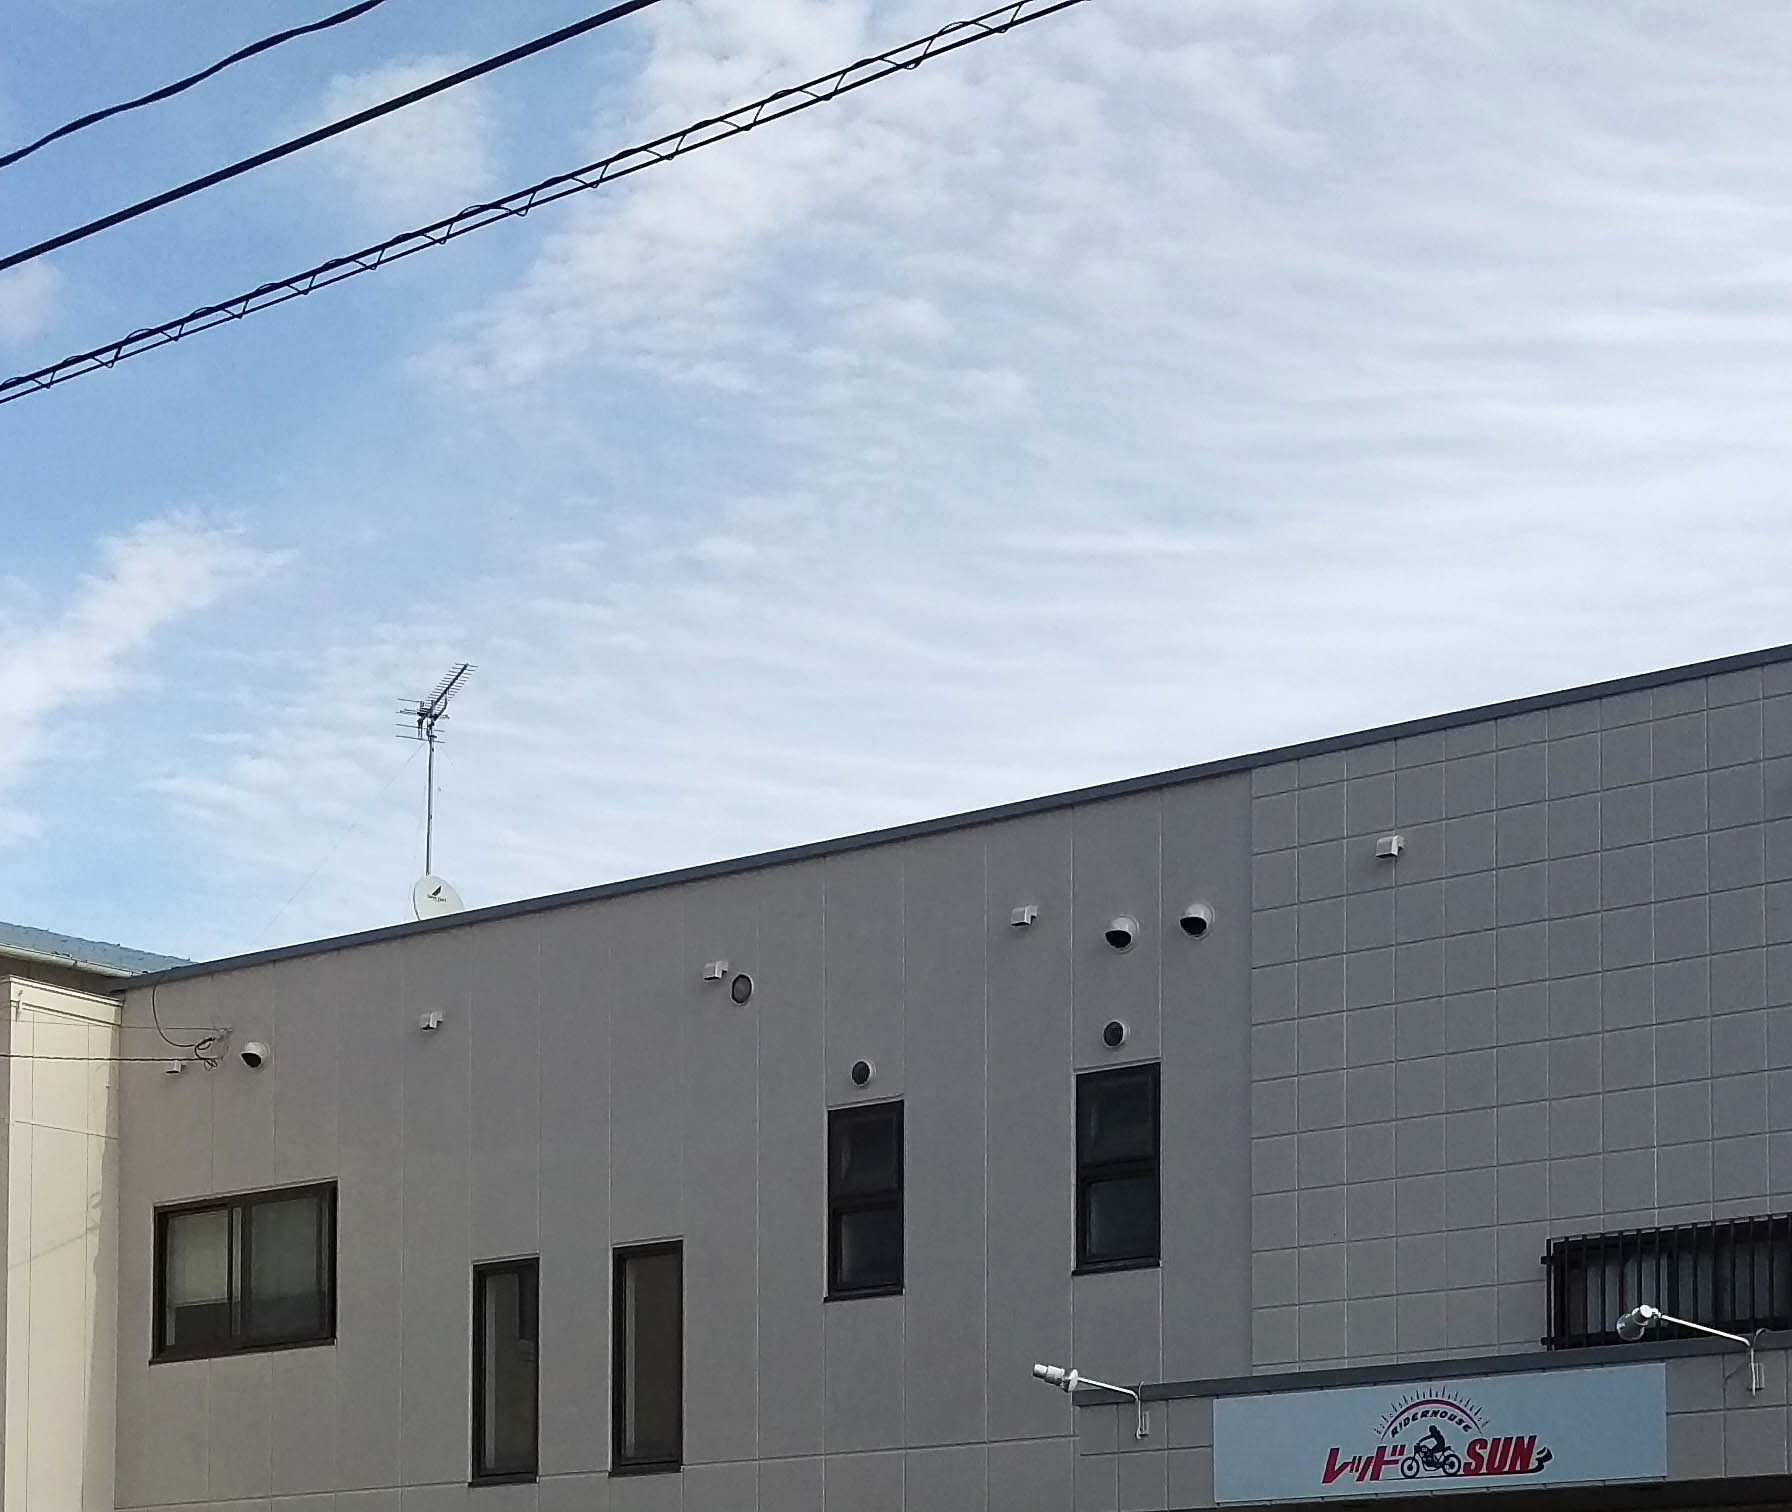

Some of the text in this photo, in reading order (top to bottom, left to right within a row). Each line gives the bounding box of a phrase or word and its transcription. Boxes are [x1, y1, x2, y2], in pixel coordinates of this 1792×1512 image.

[1391, 1408, 1472, 1438] RIDERHOUSE
[1322, 1435, 1537, 1483] レッド SUN
